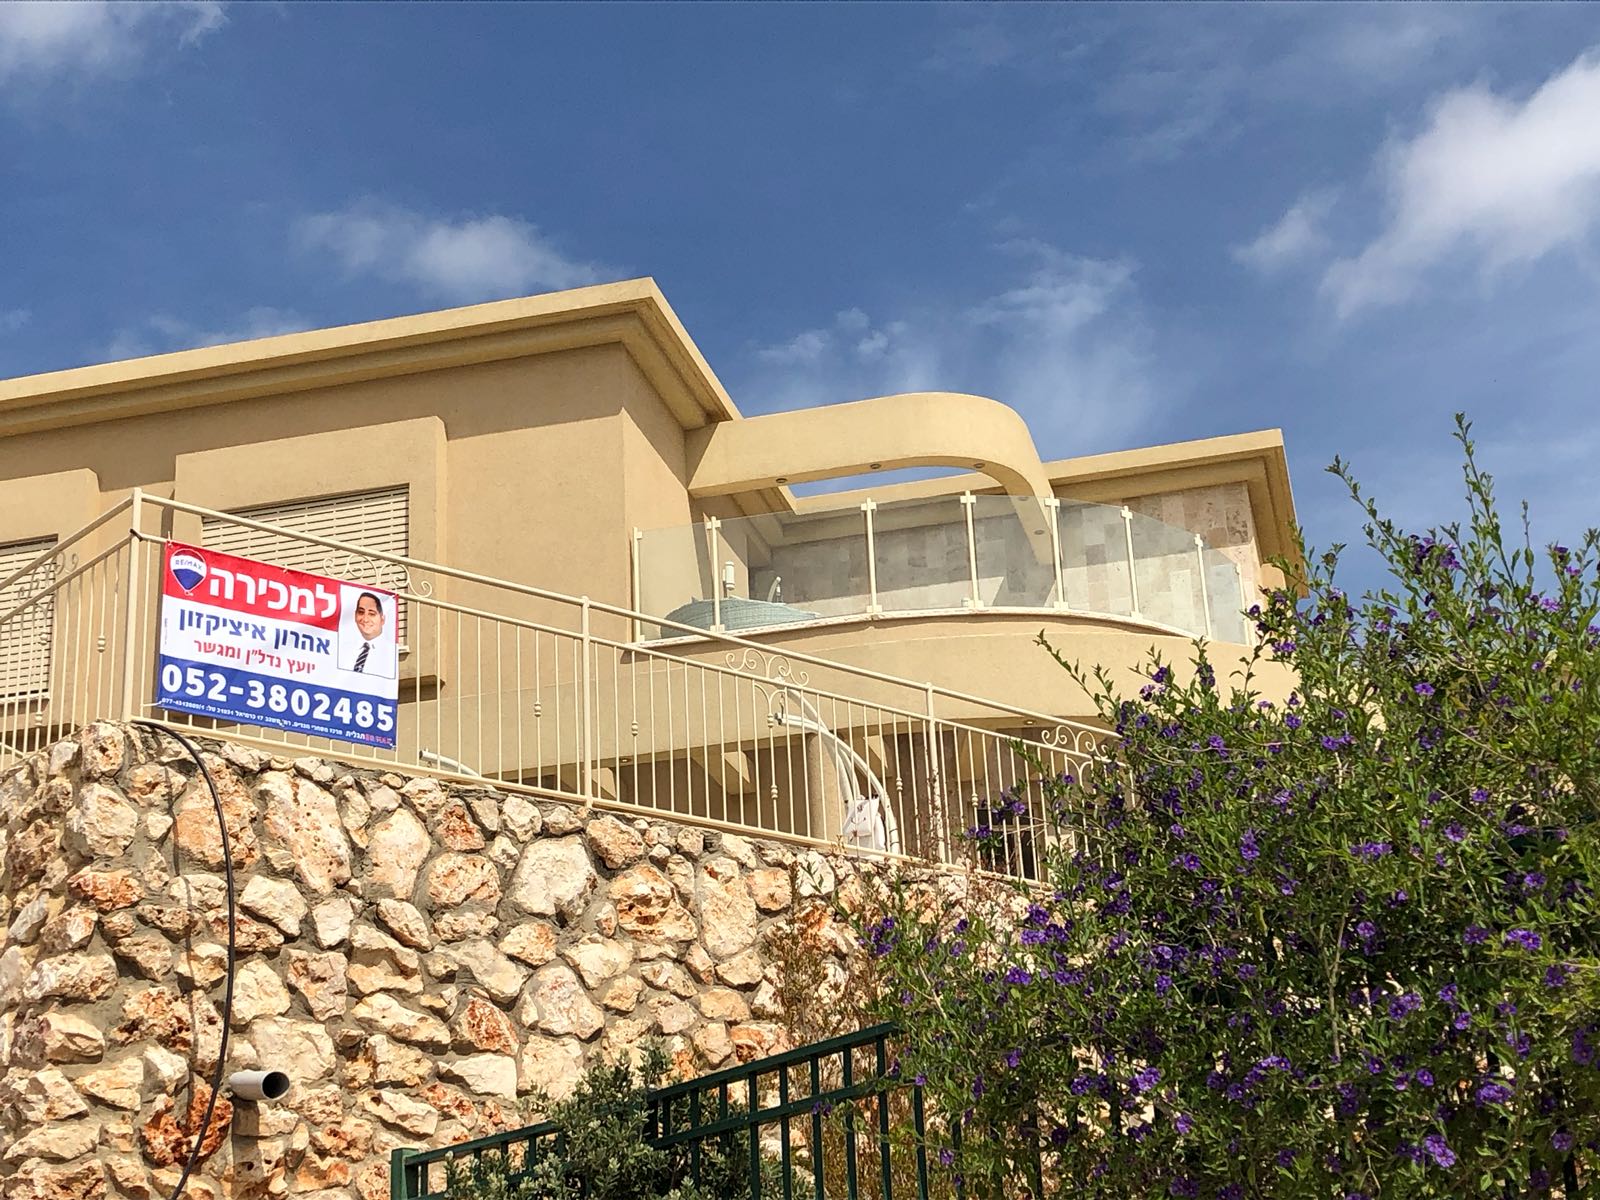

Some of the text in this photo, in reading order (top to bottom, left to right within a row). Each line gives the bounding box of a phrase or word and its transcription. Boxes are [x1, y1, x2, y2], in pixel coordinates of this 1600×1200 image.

[175, 559, 203, 571] RE/MAX
[209, 567, 337, 618] למכירה
[178, 608, 267, 641] איציקזון
[193, 640, 241, 660] ומגשר
[273, 626, 331, 655] אהרון
[286, 658, 316, 674] יועץ
[162, 664, 393, 732] 052-3802485
